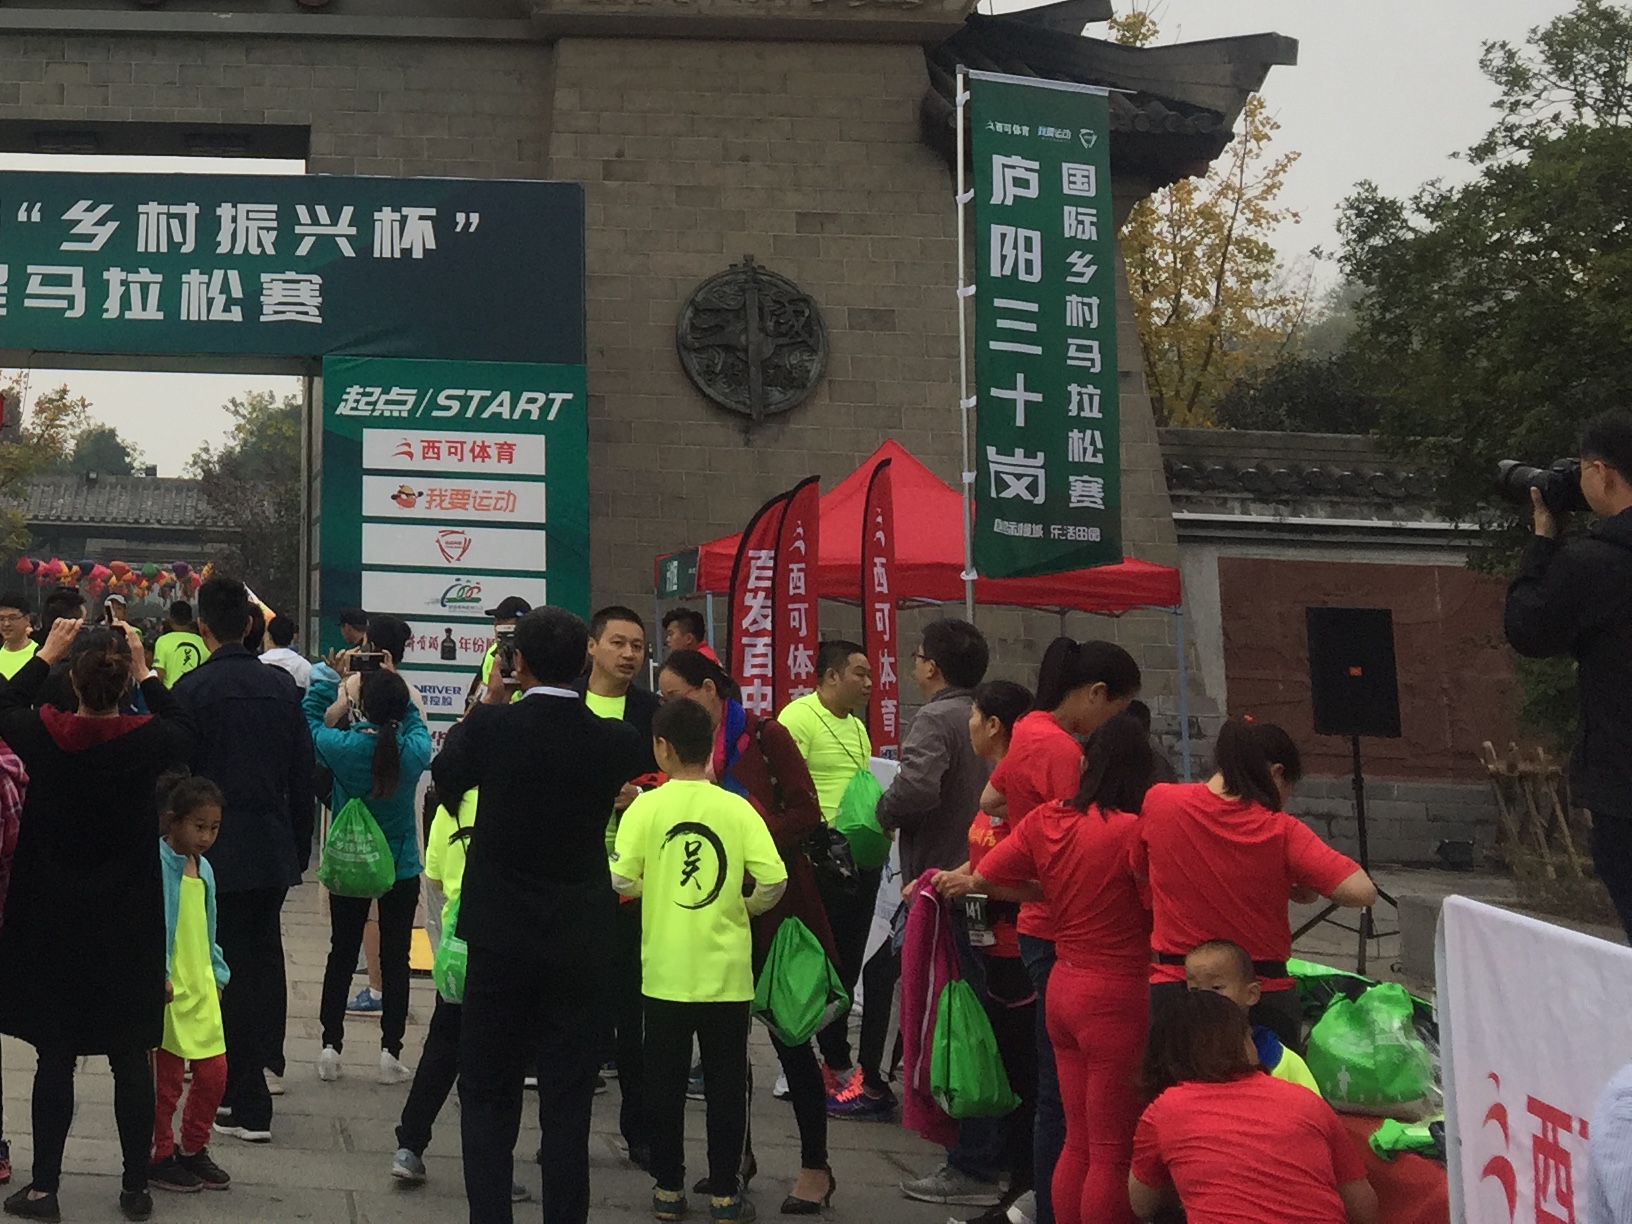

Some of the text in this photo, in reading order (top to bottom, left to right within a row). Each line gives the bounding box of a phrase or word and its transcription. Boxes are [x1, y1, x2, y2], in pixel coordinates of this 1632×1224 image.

[986, 153, 1046, 505] 庐阳三十岗
[1060, 162, 1106, 510] 国际乡村马拉松赛
[420, 438, 517, 465] 西可体育
[424, 486, 518, 514] 我要运动
[741, 549, 776, 716] 百发百中
[873, 557, 898, 738] 西可体育
